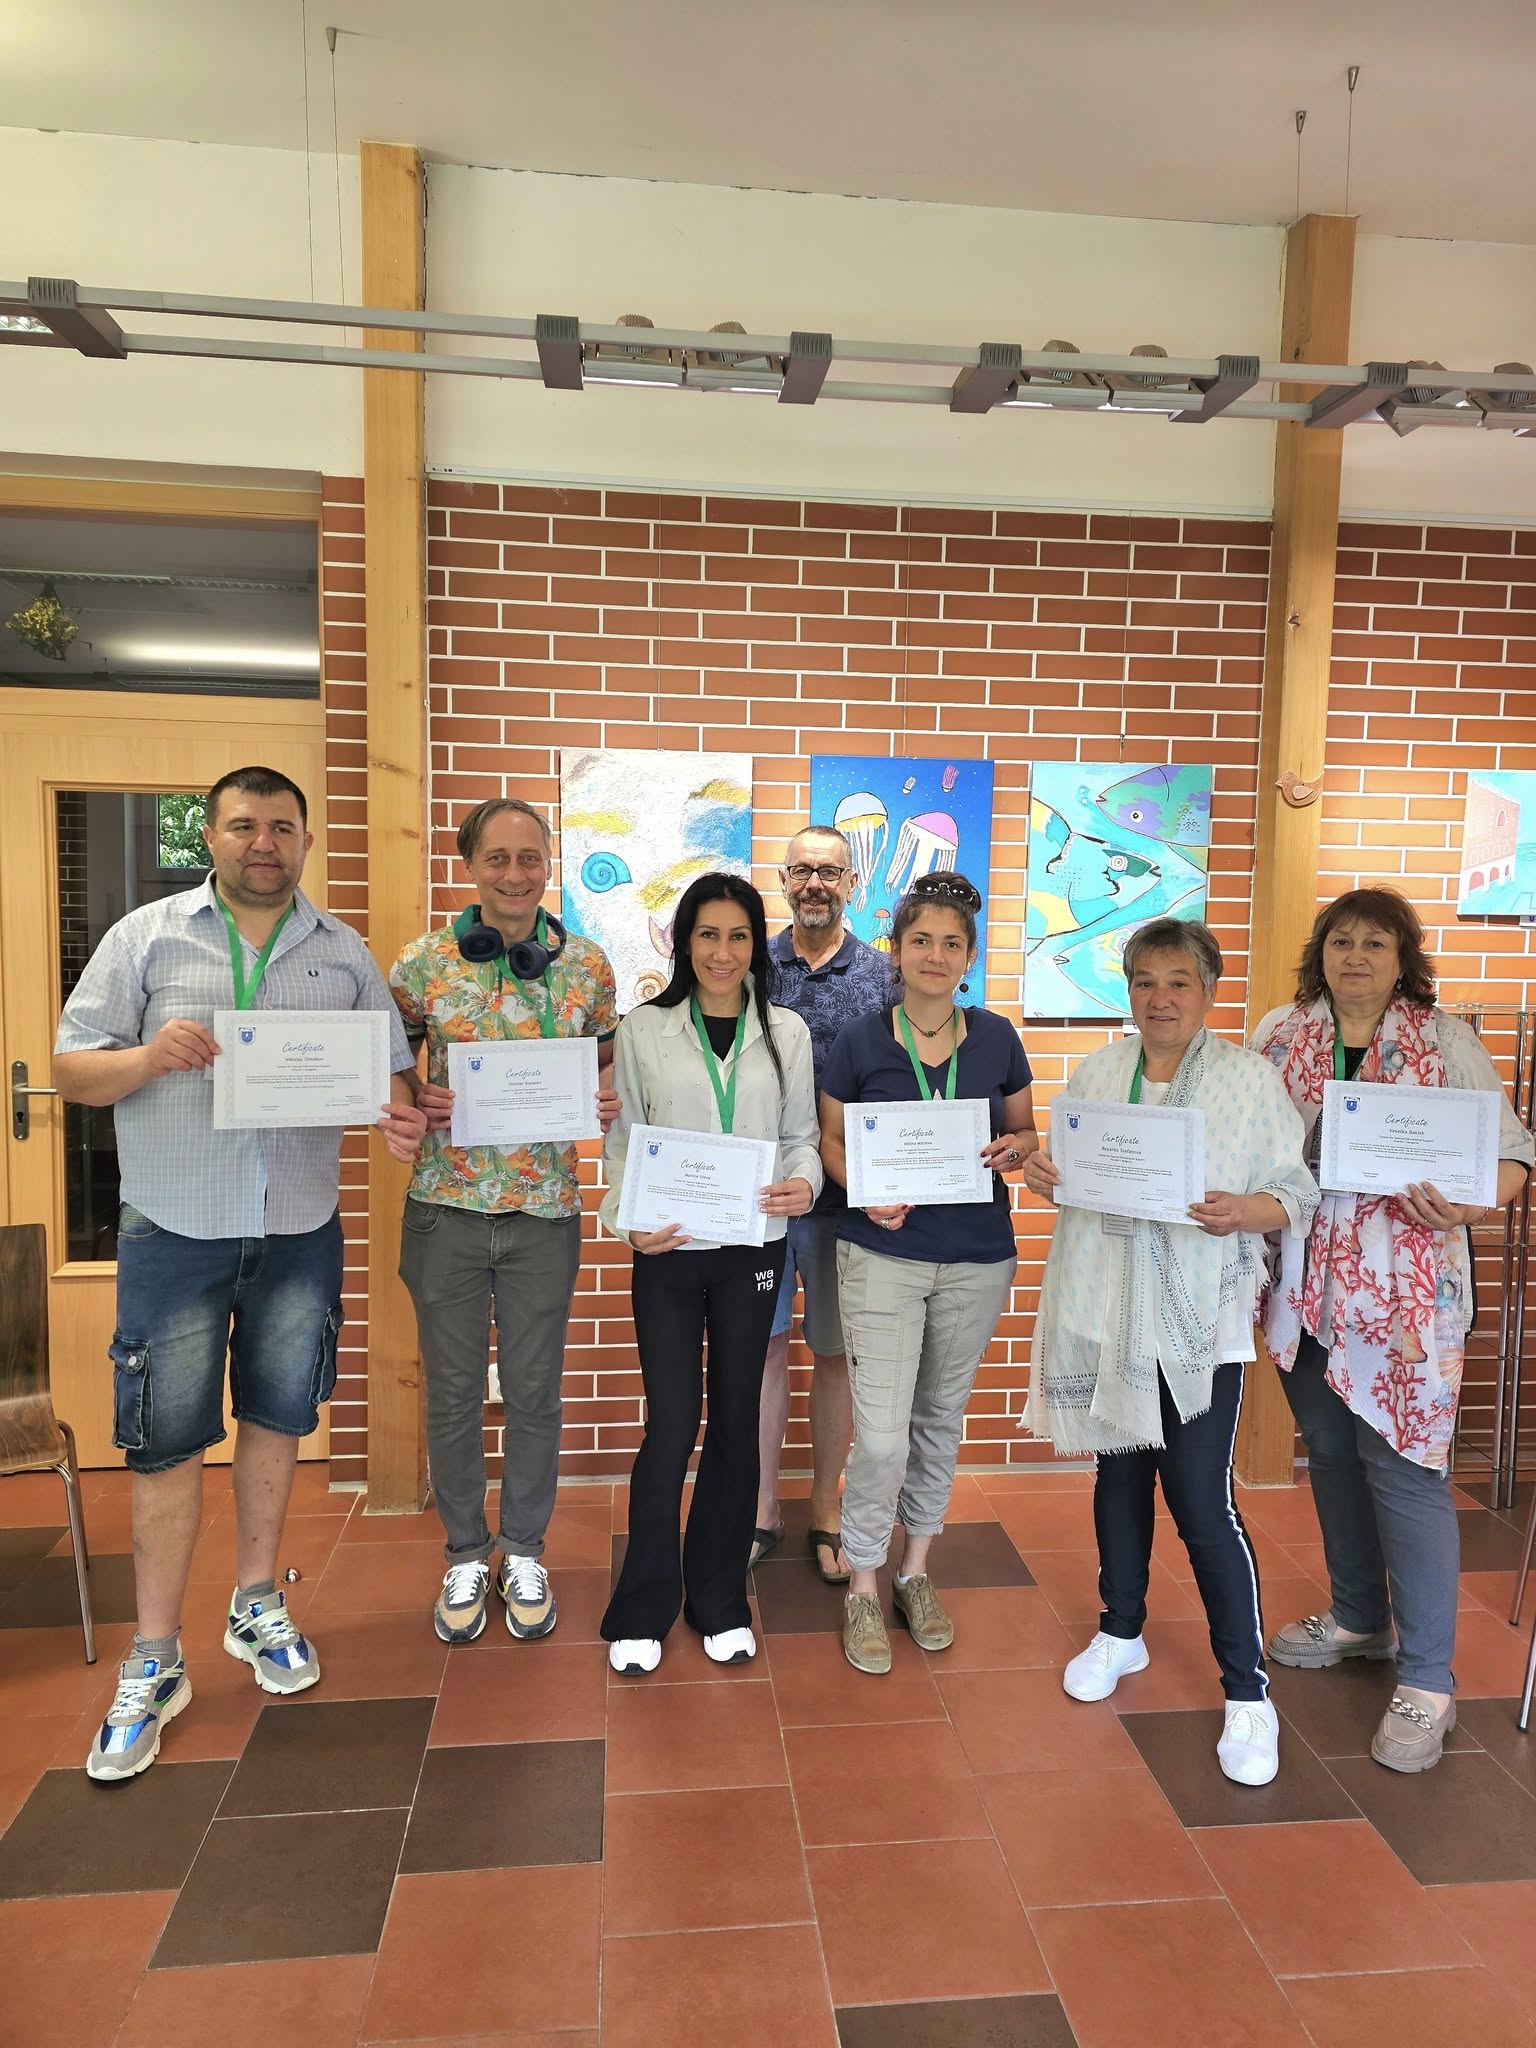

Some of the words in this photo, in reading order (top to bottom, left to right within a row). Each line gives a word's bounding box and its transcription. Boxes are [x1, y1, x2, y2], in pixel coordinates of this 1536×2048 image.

[282, 1042, 325, 1055] Certificate
[506, 1068, 541, 1079] Certificate
[1385, 1113, 1428, 1128] Certificate
[899, 1128, 934, 1140] Certificate
[1101, 1131, 1140, 1146] Certificate
[680, 1159, 716, 1172] Certificate
